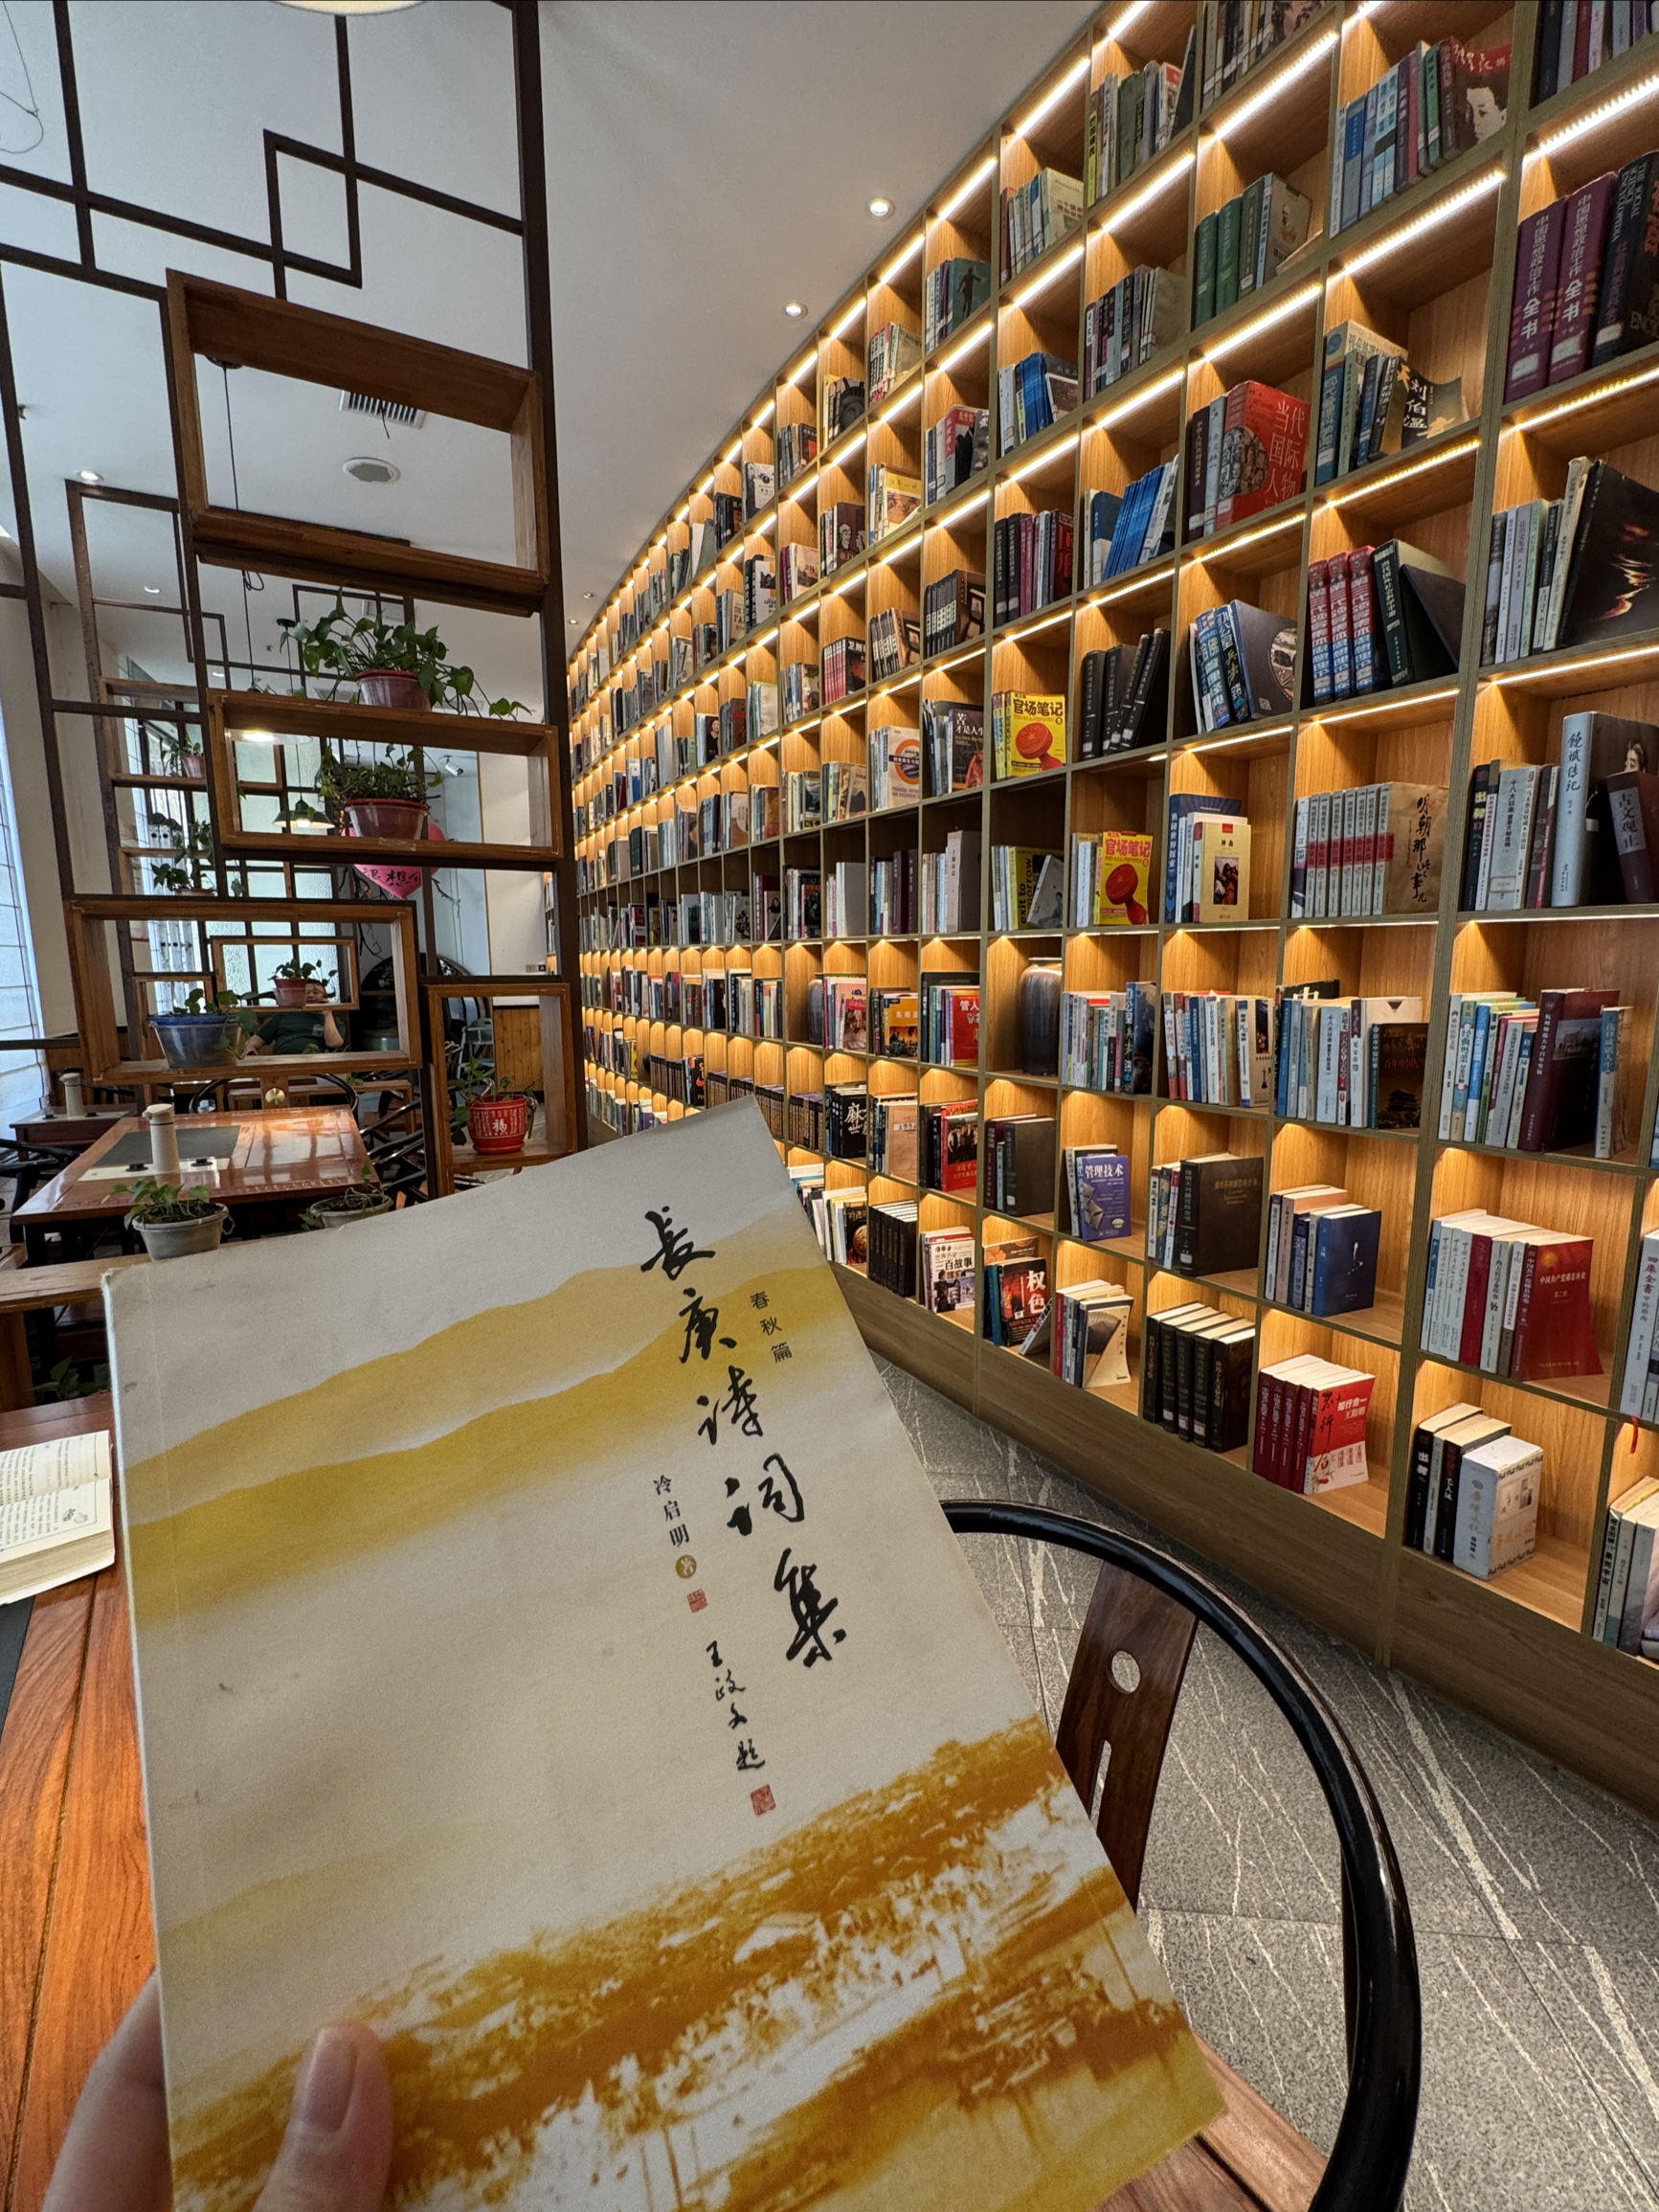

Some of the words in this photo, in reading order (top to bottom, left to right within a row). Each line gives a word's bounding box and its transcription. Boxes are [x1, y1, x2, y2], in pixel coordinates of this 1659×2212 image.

[1273, 399, 1306, 439] 当代
[1403, 378, 1428, 429] 刘伯温
[1268, 433, 1301, 470] 国际
[1265, 468, 1297, 501] 人物
[1013, 699, 1063, 717] 官场笔记
[1619, 793, 1642, 848] 古文观止
[1105, 839, 1152, 858] 官场笔记
[1411, 793, 1432, 903] 明朝那些事儿
[1085, 1162, 1124, 1179] 管理技术
[1026, 1270, 1046, 1315] 权色
[750, 1290, 793, 1364] 春秋篇
[653, 1474, 691, 1547] 冷启明
